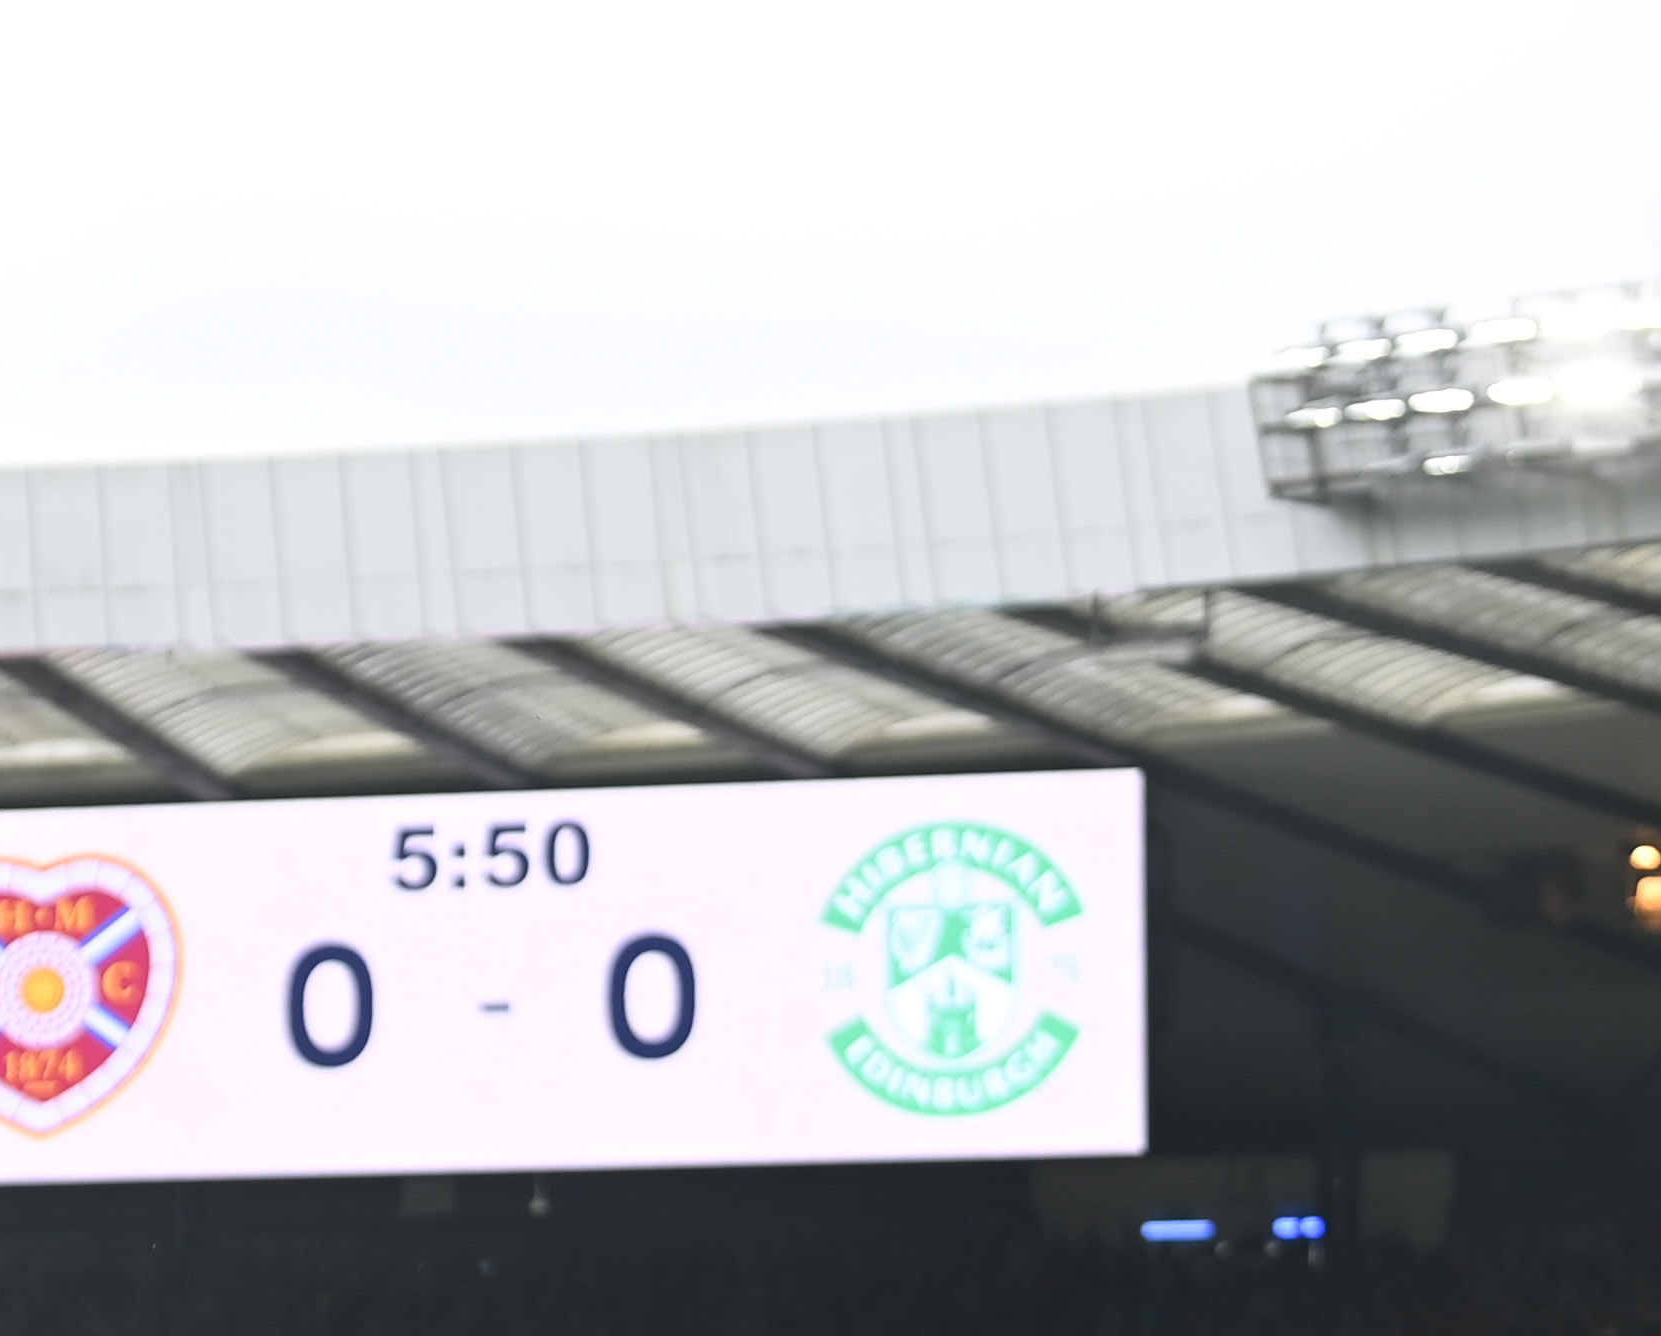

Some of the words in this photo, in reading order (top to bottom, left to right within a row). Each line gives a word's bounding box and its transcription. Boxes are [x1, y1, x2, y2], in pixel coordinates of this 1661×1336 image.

[393, 820, 590, 890] 5:50
[831, 826, 1070, 918] HIBERNIAN
[287, 943, 373, 1067] 0
[609, 933, 695, 1058] 0
[843, 1027, 1061, 1112] EDINBURGH
